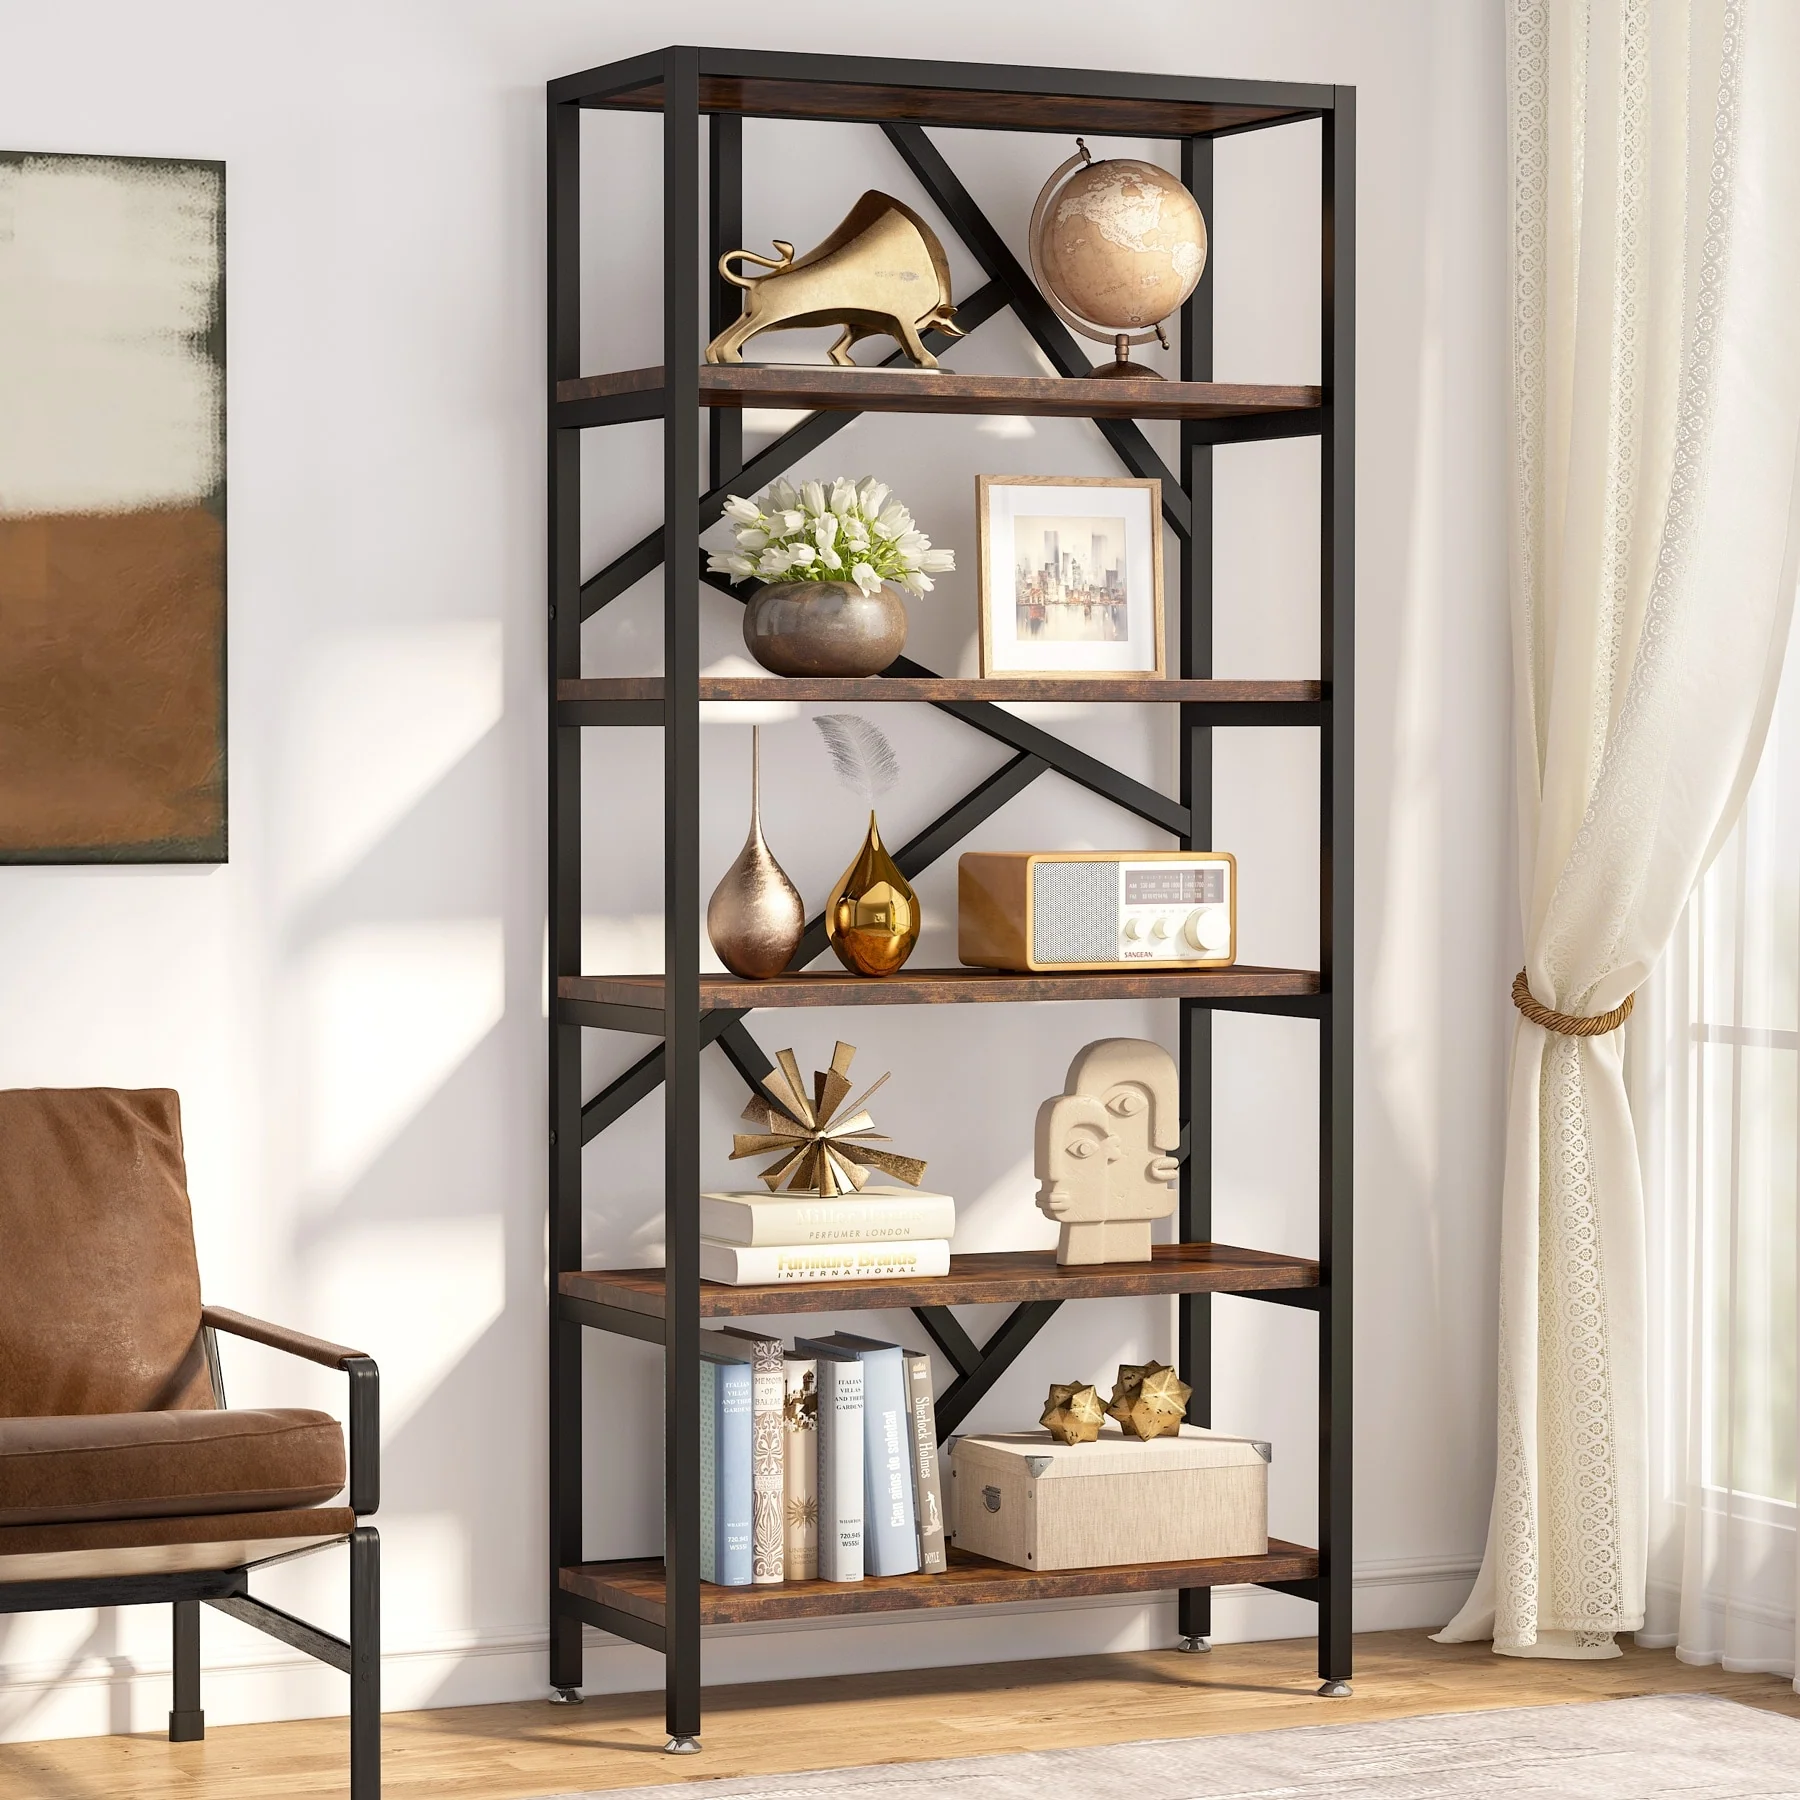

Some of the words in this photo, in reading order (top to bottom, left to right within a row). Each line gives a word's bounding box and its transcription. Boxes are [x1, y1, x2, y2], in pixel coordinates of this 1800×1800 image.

[796, 1208, 856, 1226] Miller
[809, 1230, 860, 1239] PERFUMER
[866, 1227, 911, 1237] LONDON
[777, 1252, 853, 1270] Furniture
[857, 1250, 917, 1266] Brands
[778, 1267, 916, 1278] INTERNATIONAL
[916, 1396, 932, 1440] Sherlock
[883, 1410, 899, 1454] soledad
[887, 1456, 900, 1471] de
[919, 1442, 934, 1479] Holmes
[888, 1472, 903, 1500] años
[891, 1501, 905, 1528] Cien
[924, 1551, 940, 1564] DOYLE
